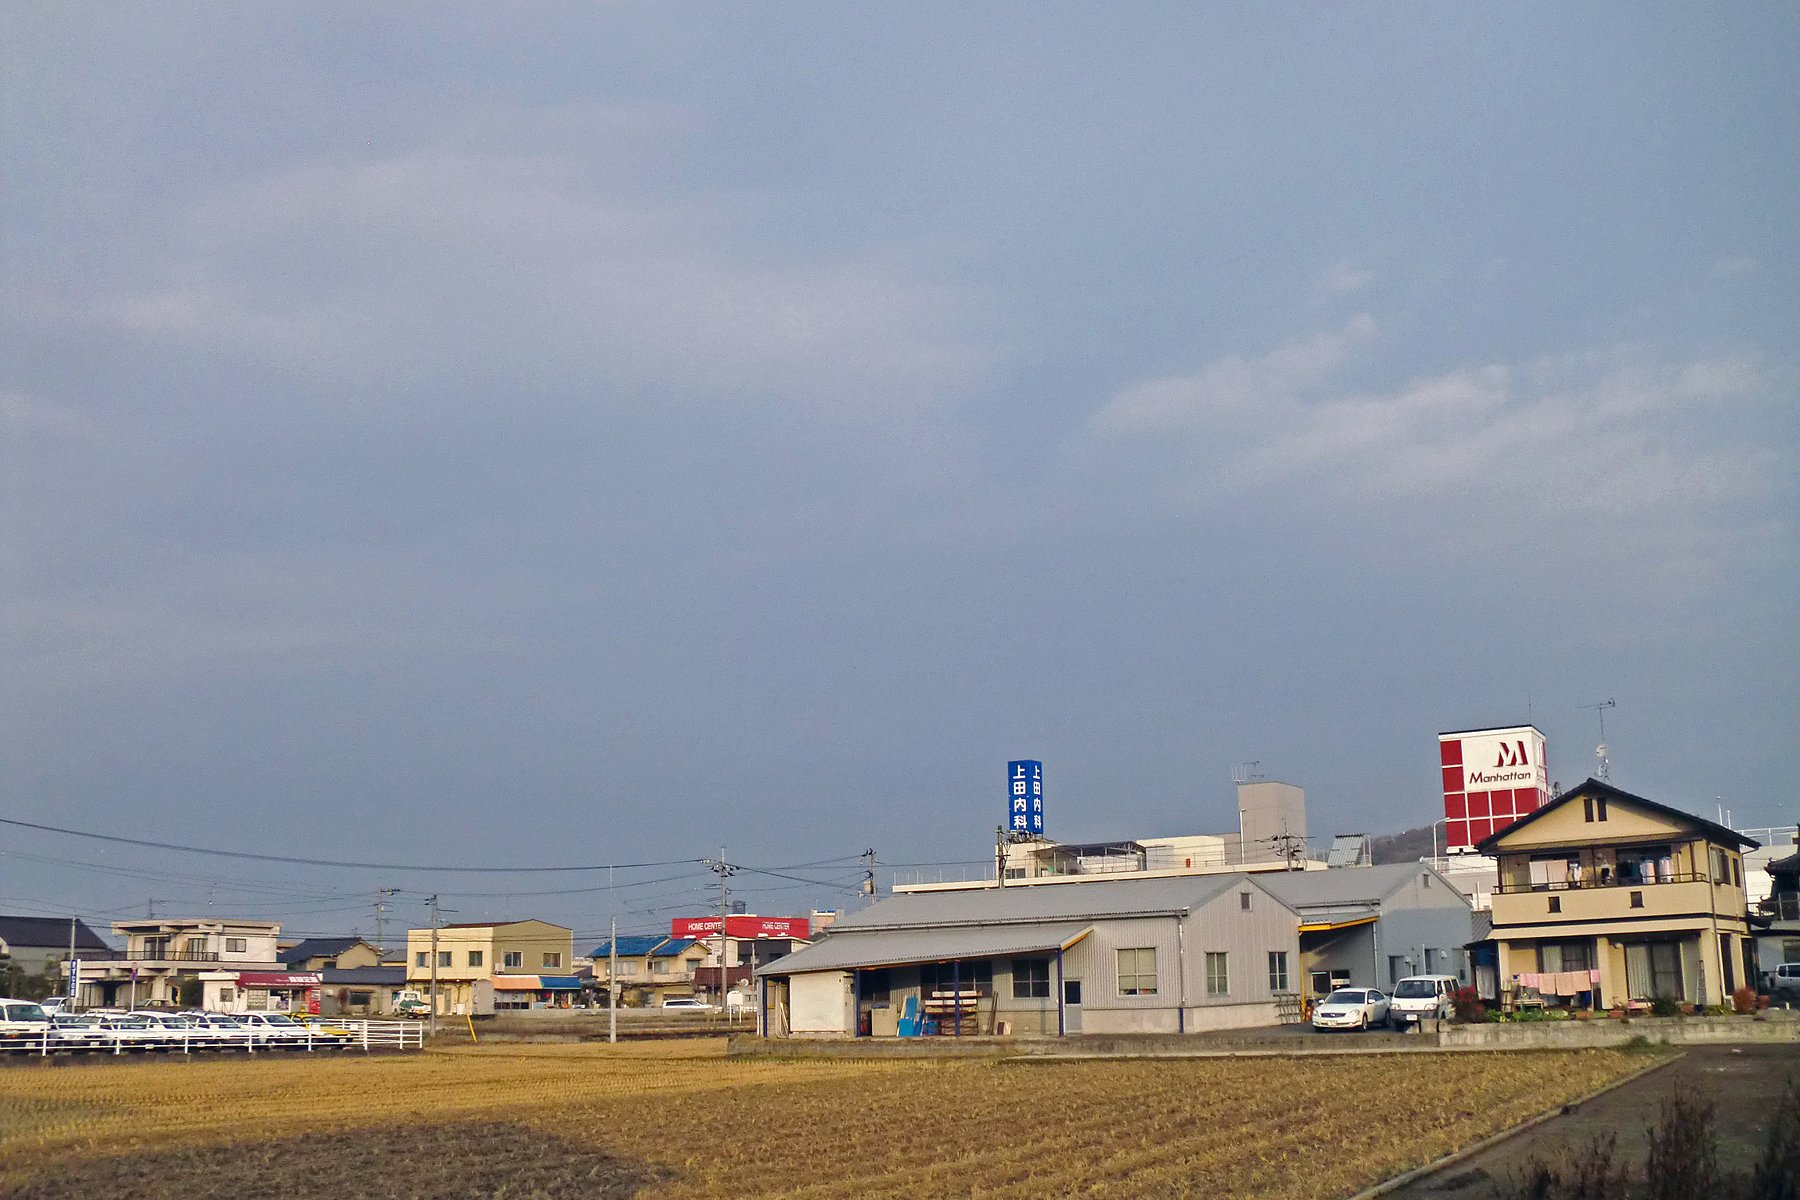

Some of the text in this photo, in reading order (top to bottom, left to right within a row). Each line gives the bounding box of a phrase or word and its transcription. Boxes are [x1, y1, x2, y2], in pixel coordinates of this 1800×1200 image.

[1469, 772, 1531, 784] Manhattan
[1013, 765, 1027, 829] 上田内科
[1033, 765, 1042, 829] 上田内科
[688, 922, 722, 931] HOME CENTE
[762, 922, 790, 930] HOME CENTER
